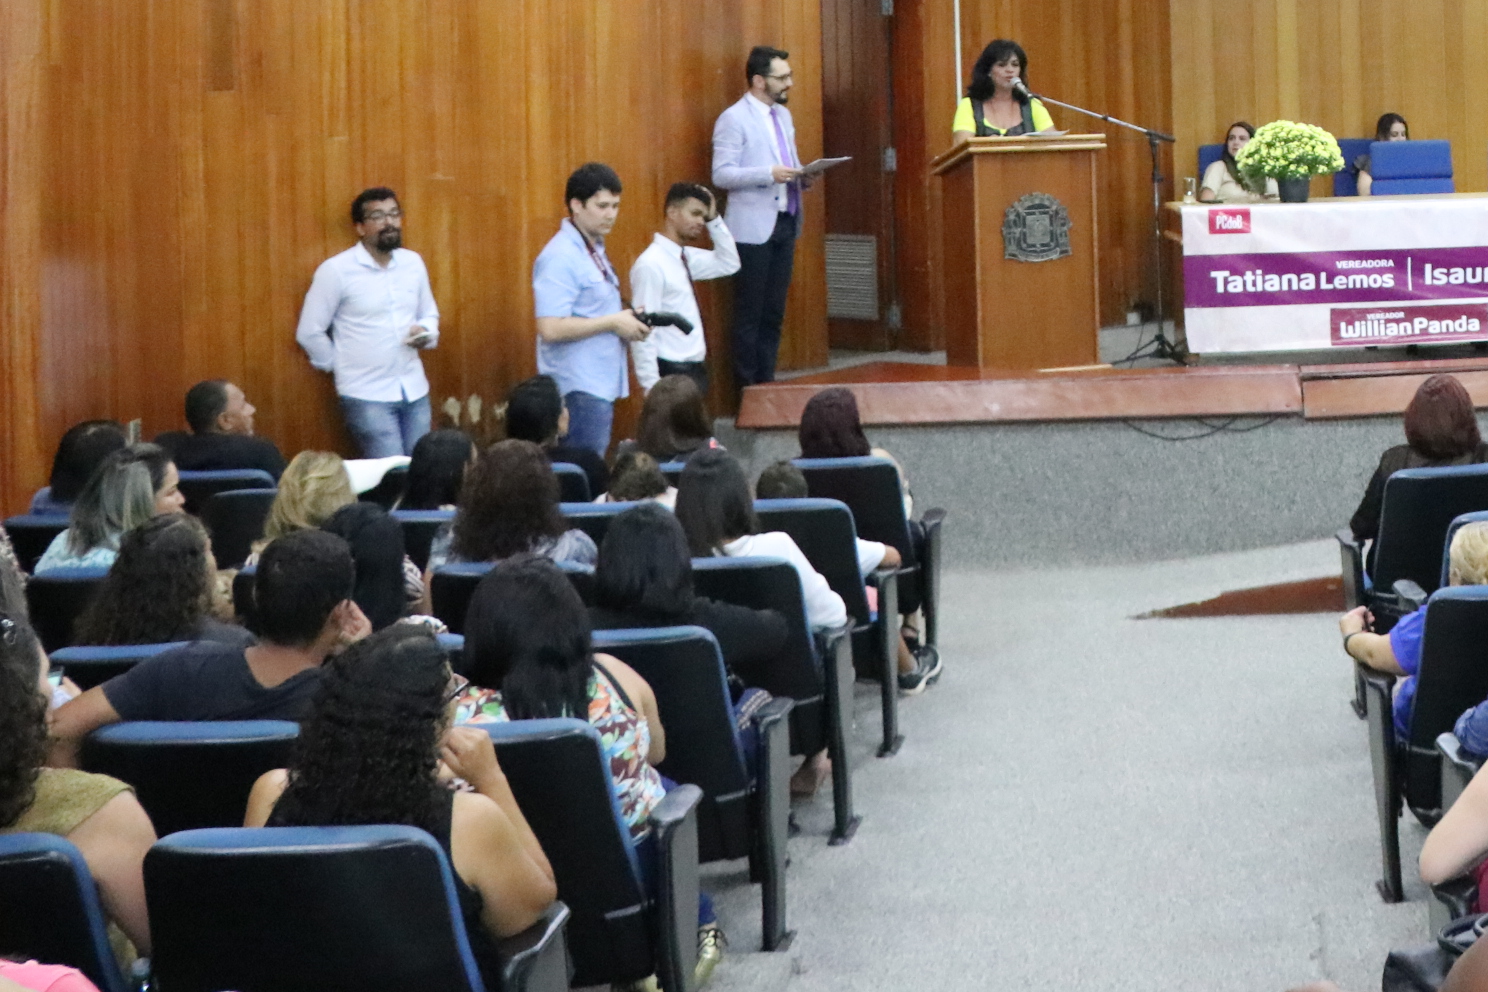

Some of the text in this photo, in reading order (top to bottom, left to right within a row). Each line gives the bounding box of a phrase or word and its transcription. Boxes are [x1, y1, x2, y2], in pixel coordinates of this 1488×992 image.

[1215, 214, 1243, 230] PCdoB
[1335, 259, 1395, 269] VEREADORA
[1210, 269, 1395, 294] Tatiana Lemos
[1366, 311, 1405, 320] VEREADOR
